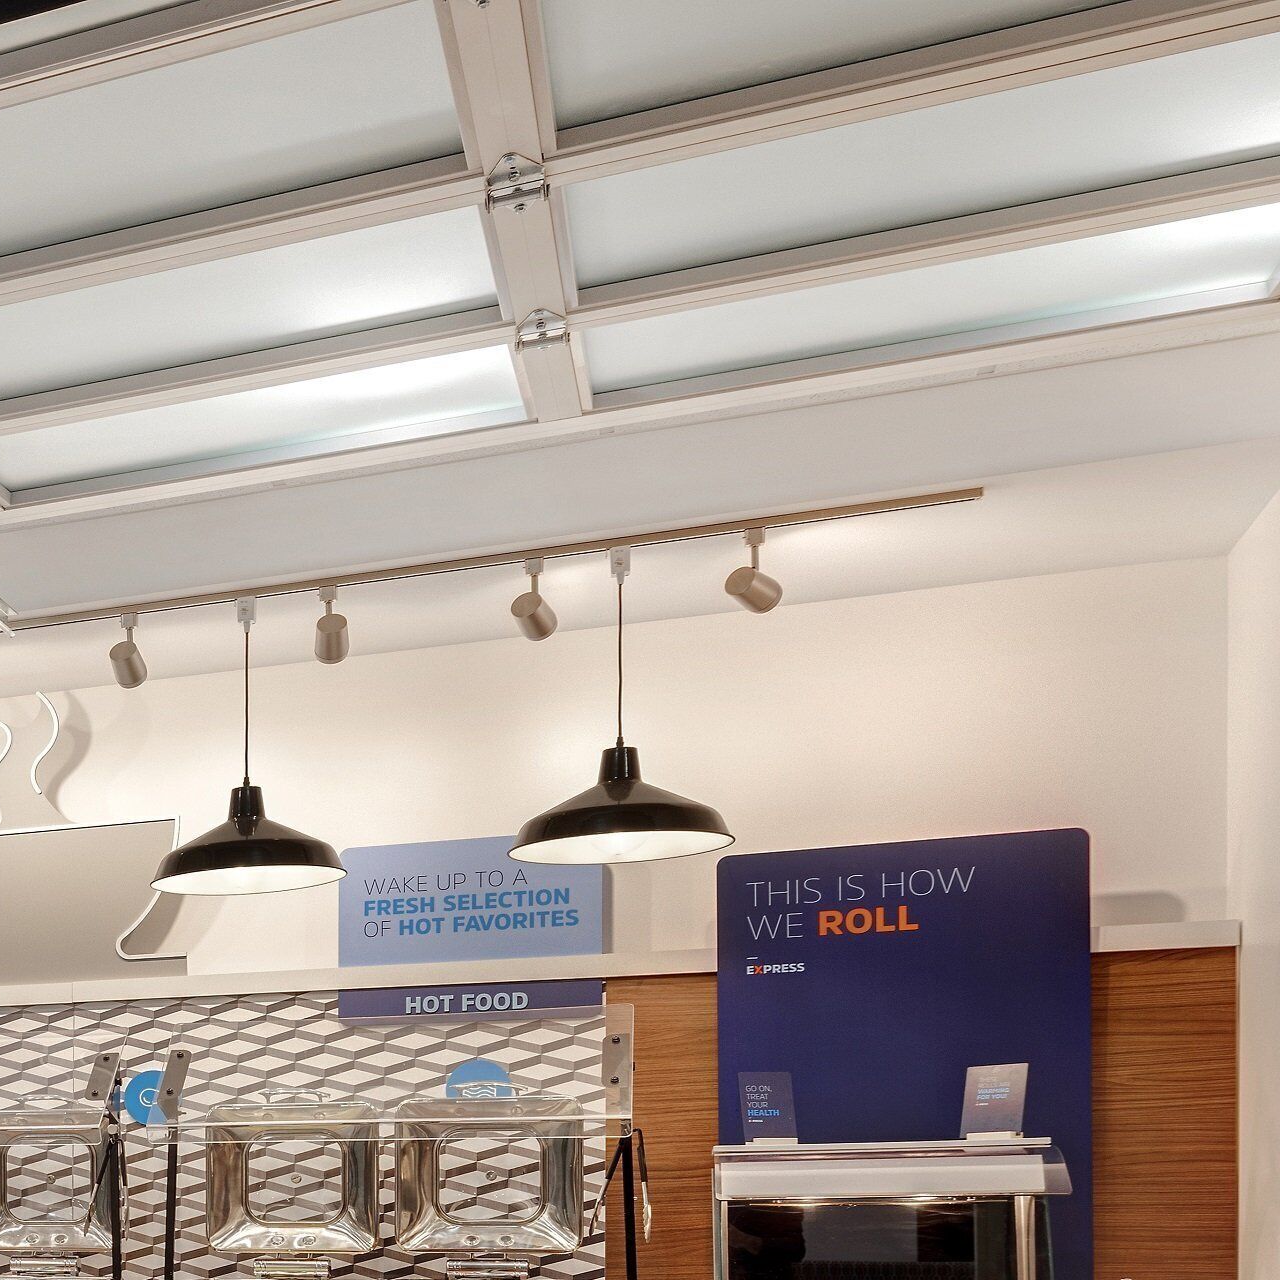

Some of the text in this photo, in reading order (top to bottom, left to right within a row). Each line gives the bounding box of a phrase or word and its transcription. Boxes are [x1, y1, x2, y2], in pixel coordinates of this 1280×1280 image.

[364, 868, 528, 895] WAKE UP TO A
[746, 866, 976, 907] THIS IS HOW
[364, 887, 570, 917] FRESH SELECTION
[363, 909, 579, 938] OF HOT FAVORITES
[746, 905, 919, 940] WE ROLL
[746, 963, 805, 975] EXPRESS
[405, 991, 529, 1014] HOT FOOD
